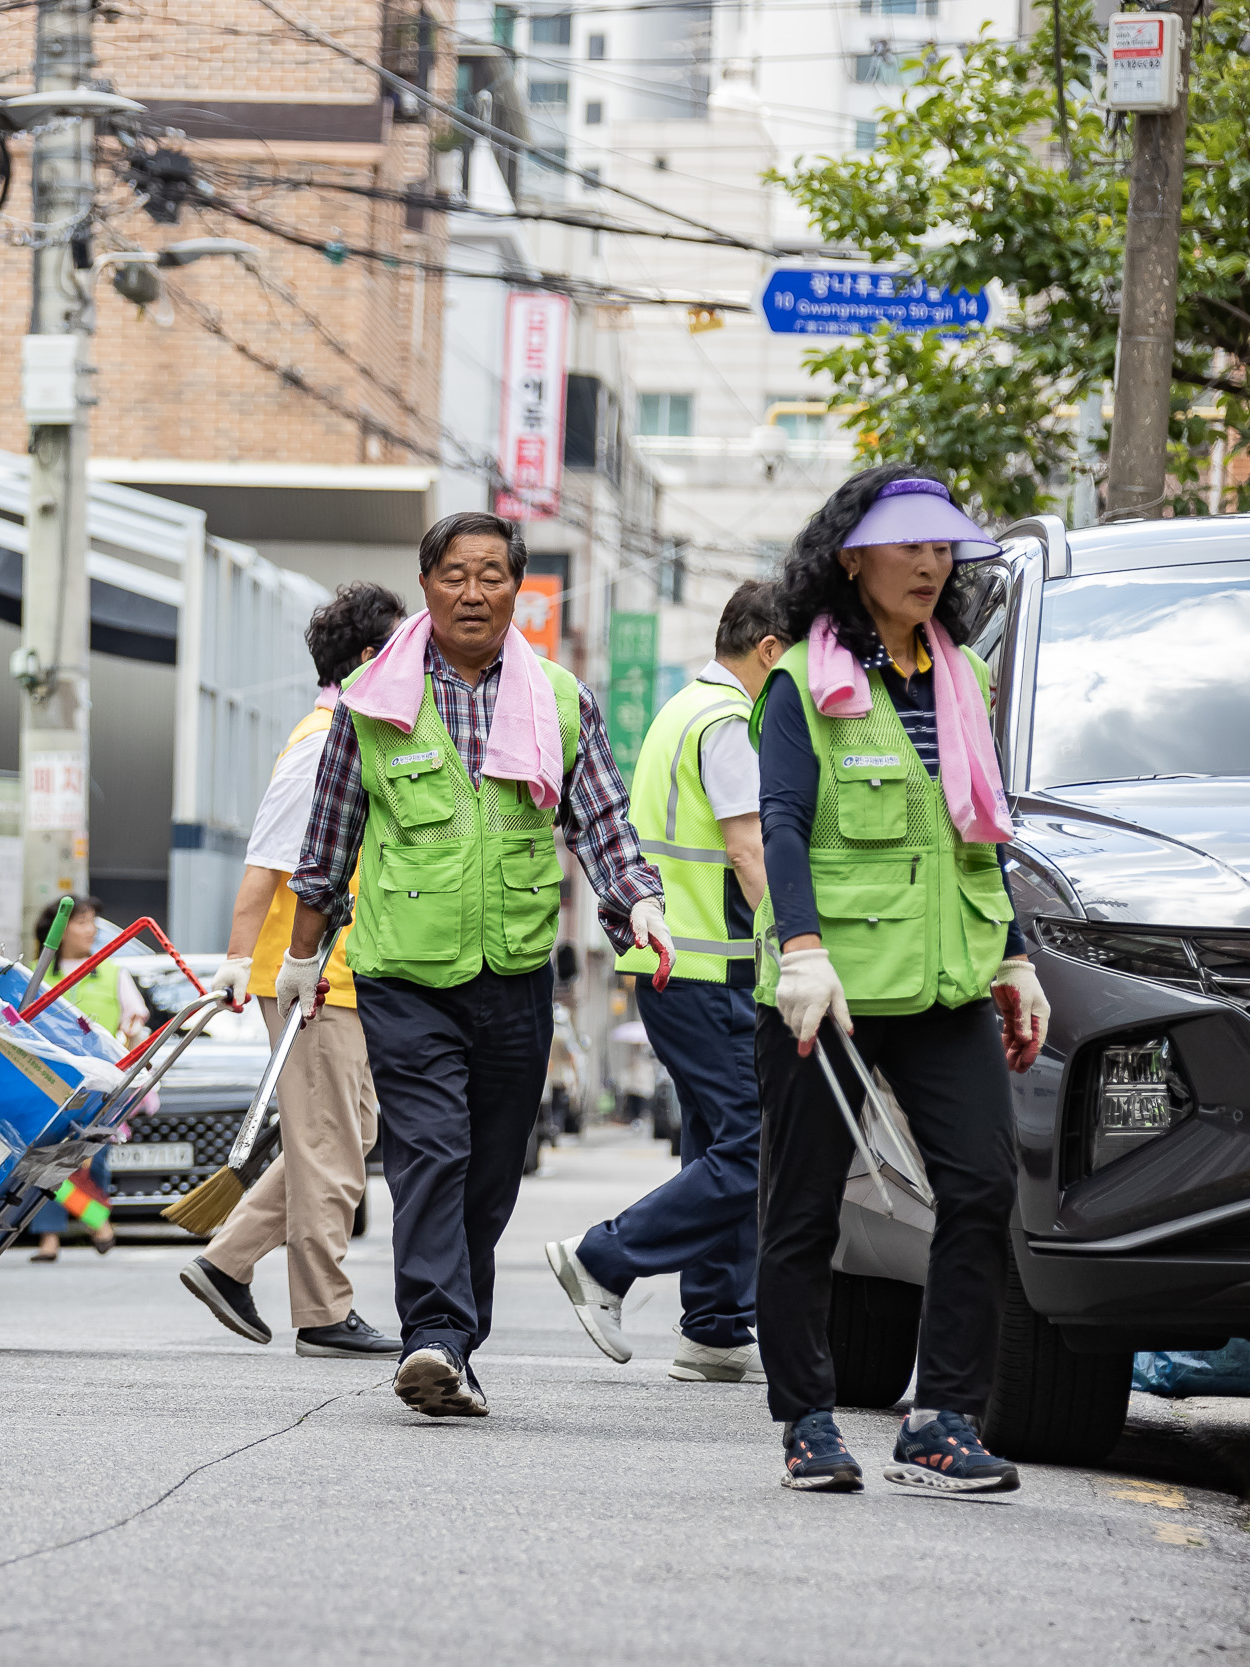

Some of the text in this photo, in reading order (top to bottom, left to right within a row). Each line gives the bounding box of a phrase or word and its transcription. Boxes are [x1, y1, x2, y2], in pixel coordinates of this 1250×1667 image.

[811, 273, 942, 303] 광나루로0
[773, 290, 794, 312] 10
[958, 297, 978, 317] 14
